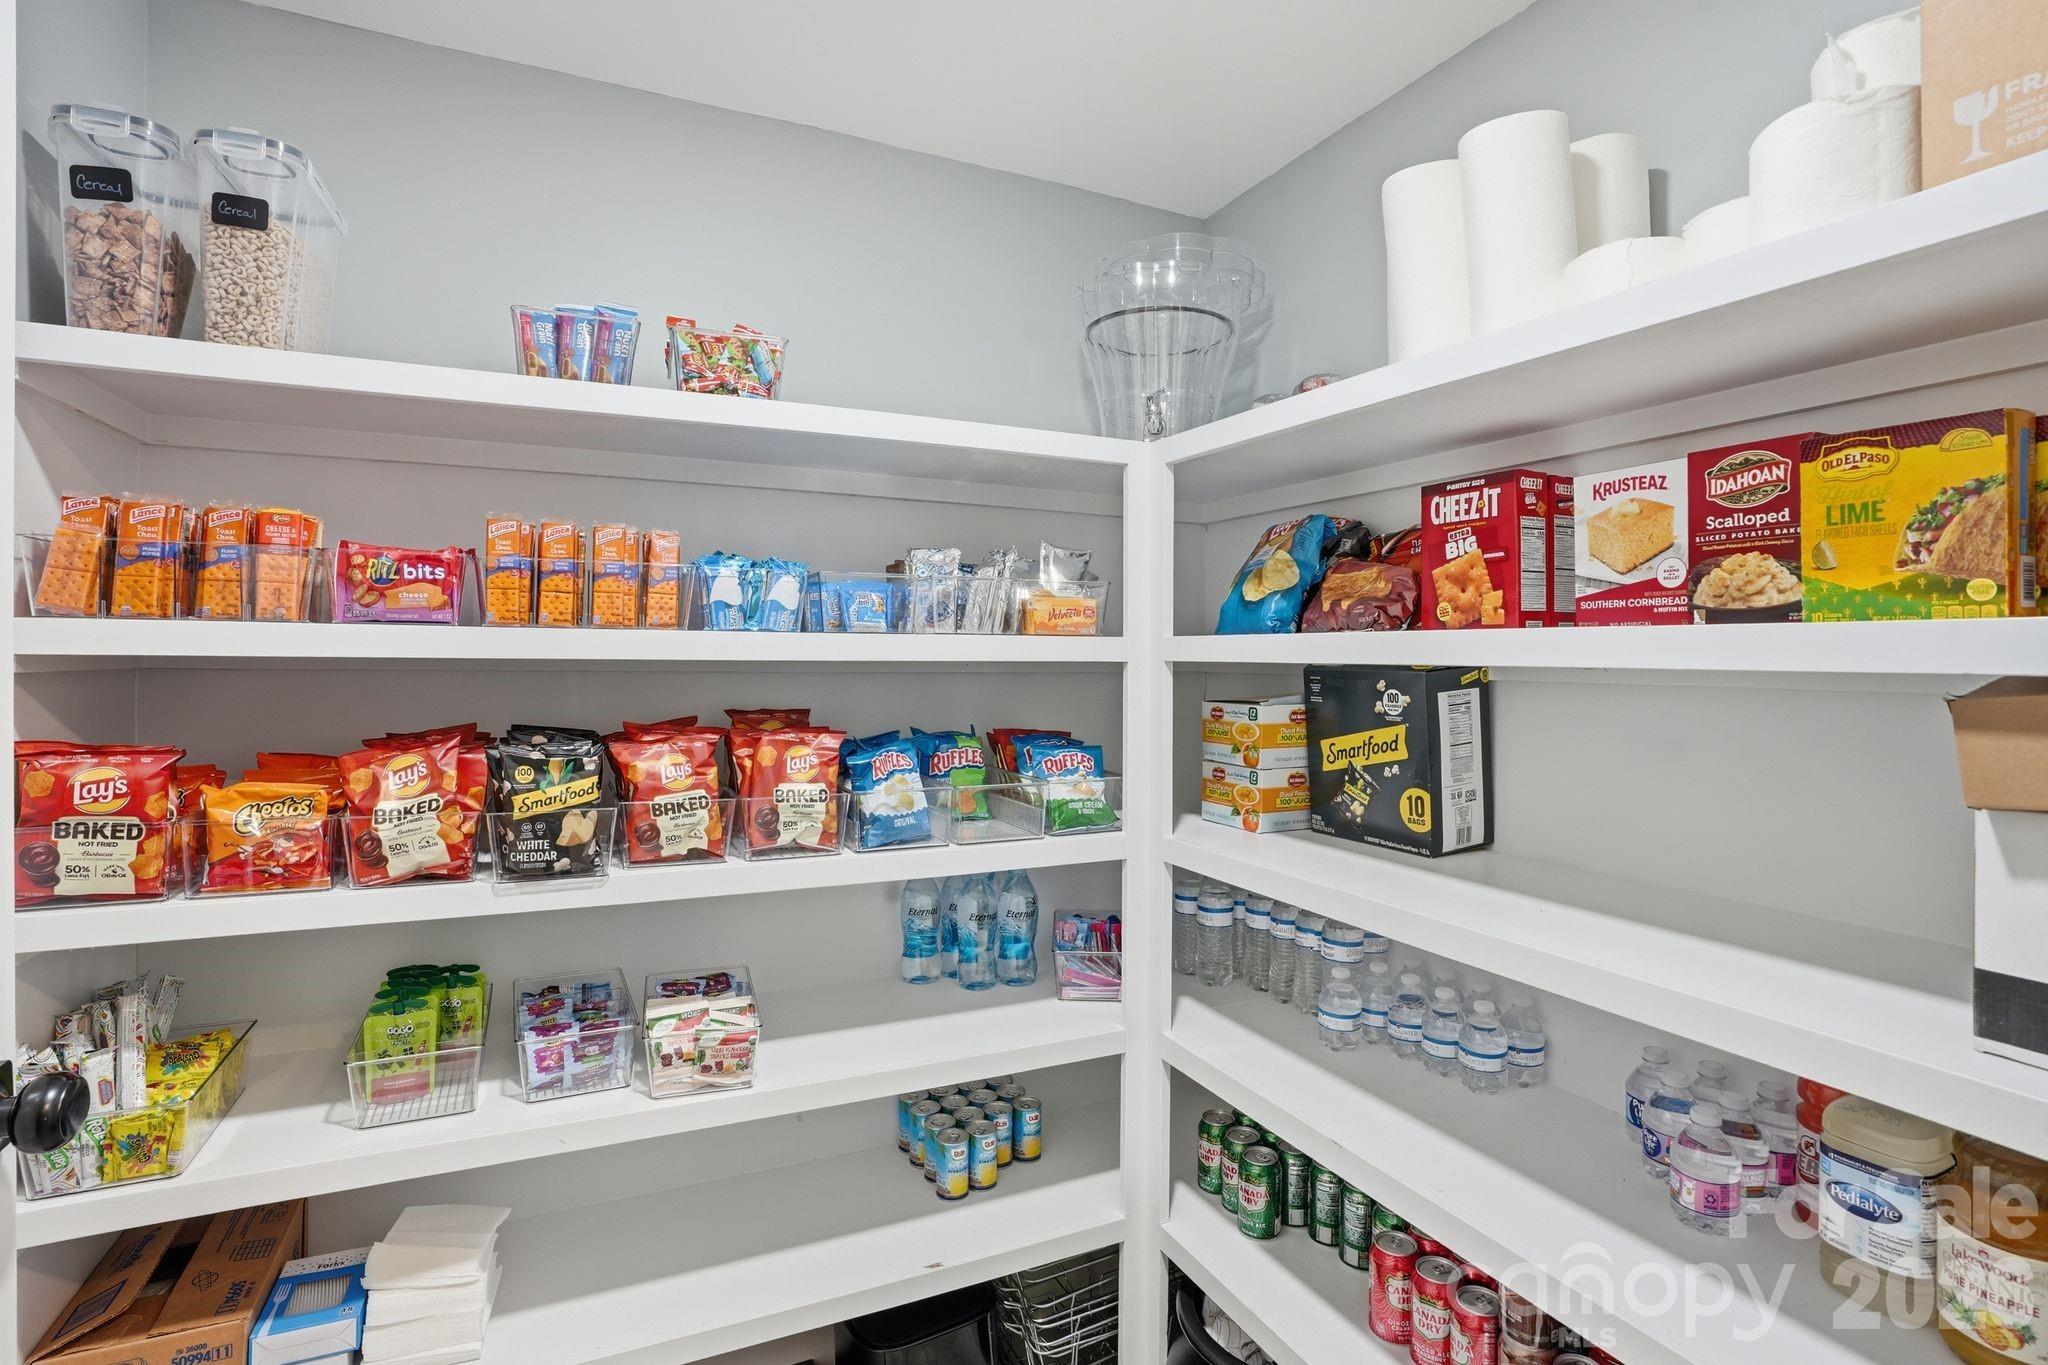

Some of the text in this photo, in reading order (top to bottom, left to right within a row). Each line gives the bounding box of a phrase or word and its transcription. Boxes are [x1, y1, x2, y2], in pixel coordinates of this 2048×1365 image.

[2005, 127, 2047, 149] KEEP
[75, 174, 123, 197] Cereal
[218, 200, 257, 221] Cereal
[1821, 458, 1843, 472] OLD
[1710, 464, 1786, 496] IDAHOAN
[1592, 475, 1667, 501] KRUSTEAZ
[64, 499, 99, 511] Lance
[131, 508, 164, 519] Lance
[210, 511, 241, 522] Lance
[1706, 508, 1791, 530] Scalloped
[1825, 499, 1885, 527] LIME
[490, 523, 516, 535] Lance
[545, 527, 571, 538] Lance
[597, 531, 621, 541] Lance
[1695, 534, 1727, 543] SLICED
[1731, 530, 1770, 539] POTATO
[1445, 536, 1478, 560] BIG
[366, 558, 446, 580] RITZ bits
[1580, 596, 1688, 610] SOUTHERN CORNBREAD
[1048, 607, 1082, 622] Velveeta
[1386, 692, 1400, 704] 100
[1326, 733, 1399, 764] Smartfood
[786, 752, 818, 774] Lay's
[871, 751, 913, 780] RUFFLES
[929, 747, 985, 776] RUFFLES
[1043, 752, 1095, 775] RUFFLES
[387, 761, 428, 791] Lay's
[517, 768, 532, 777] 100
[660, 762, 693, 785] Lay's
[73, 775, 129, 805] Lay's
[518, 781, 595, 813] Smartfood
[773, 788, 828, 804] BAKED
[373, 798, 441, 826] BAKED
[651, 794, 710, 818] BAKED
[1406, 795, 1426, 818] 10
[1408, 817, 1426, 826] BAGS
[53, 821, 144, 841] BAKED
[516, 840, 551, 851] WHITE
[665, 835, 683, 843] 50%
[388, 843, 409, 852] 50%
[510, 851, 558, 862] CHEDDAR
[64, 865, 91, 874] 50%
[908, 907, 939, 916] Eternal
[969, 912, 998, 921] Eternal
[1005, 909, 1036, 919] Eternal
[1239, 1184, 1269, 1200] ANADA
[1241, 1195, 1259, 1206] DRY
[1830, 1183, 1900, 1222] Pedialyte
[317, 1261, 345, 1269] Forks
[1951, 1242, 2030, 1287] Lakewood
[1398, 1297, 1411, 1305] DR
[1968, 1281, 2041, 1319] PINEAPPLE
[1418, 1319, 1442, 1334] DRY
[186, 1343, 208, 1353] 36000
[171, 1352, 212, 1365] 50994
